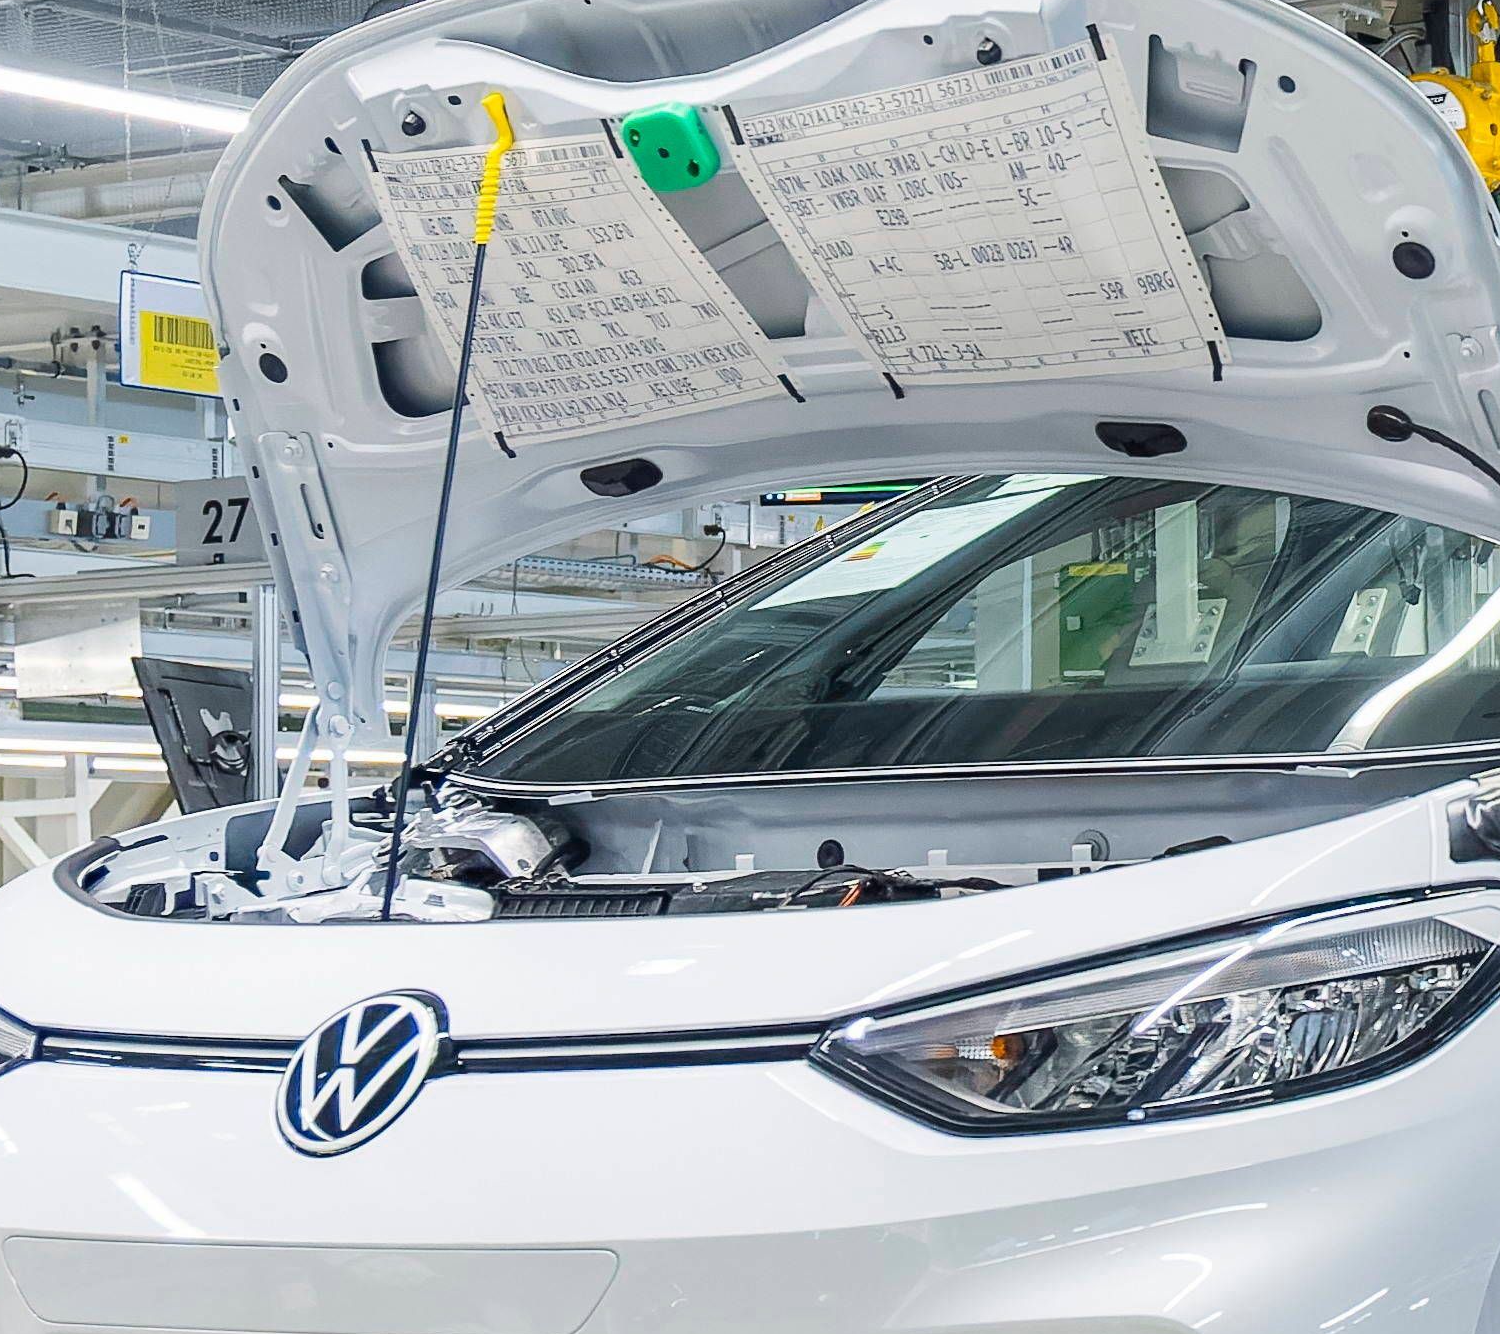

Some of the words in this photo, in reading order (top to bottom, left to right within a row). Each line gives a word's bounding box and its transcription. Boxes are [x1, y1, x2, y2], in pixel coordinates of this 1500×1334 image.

[741, 118, 778, 137] E123
[848, 87, 926, 116] 42-3-5727
[935, 77, 974, 98] 5673
[202, 498, 250, 547] 27
